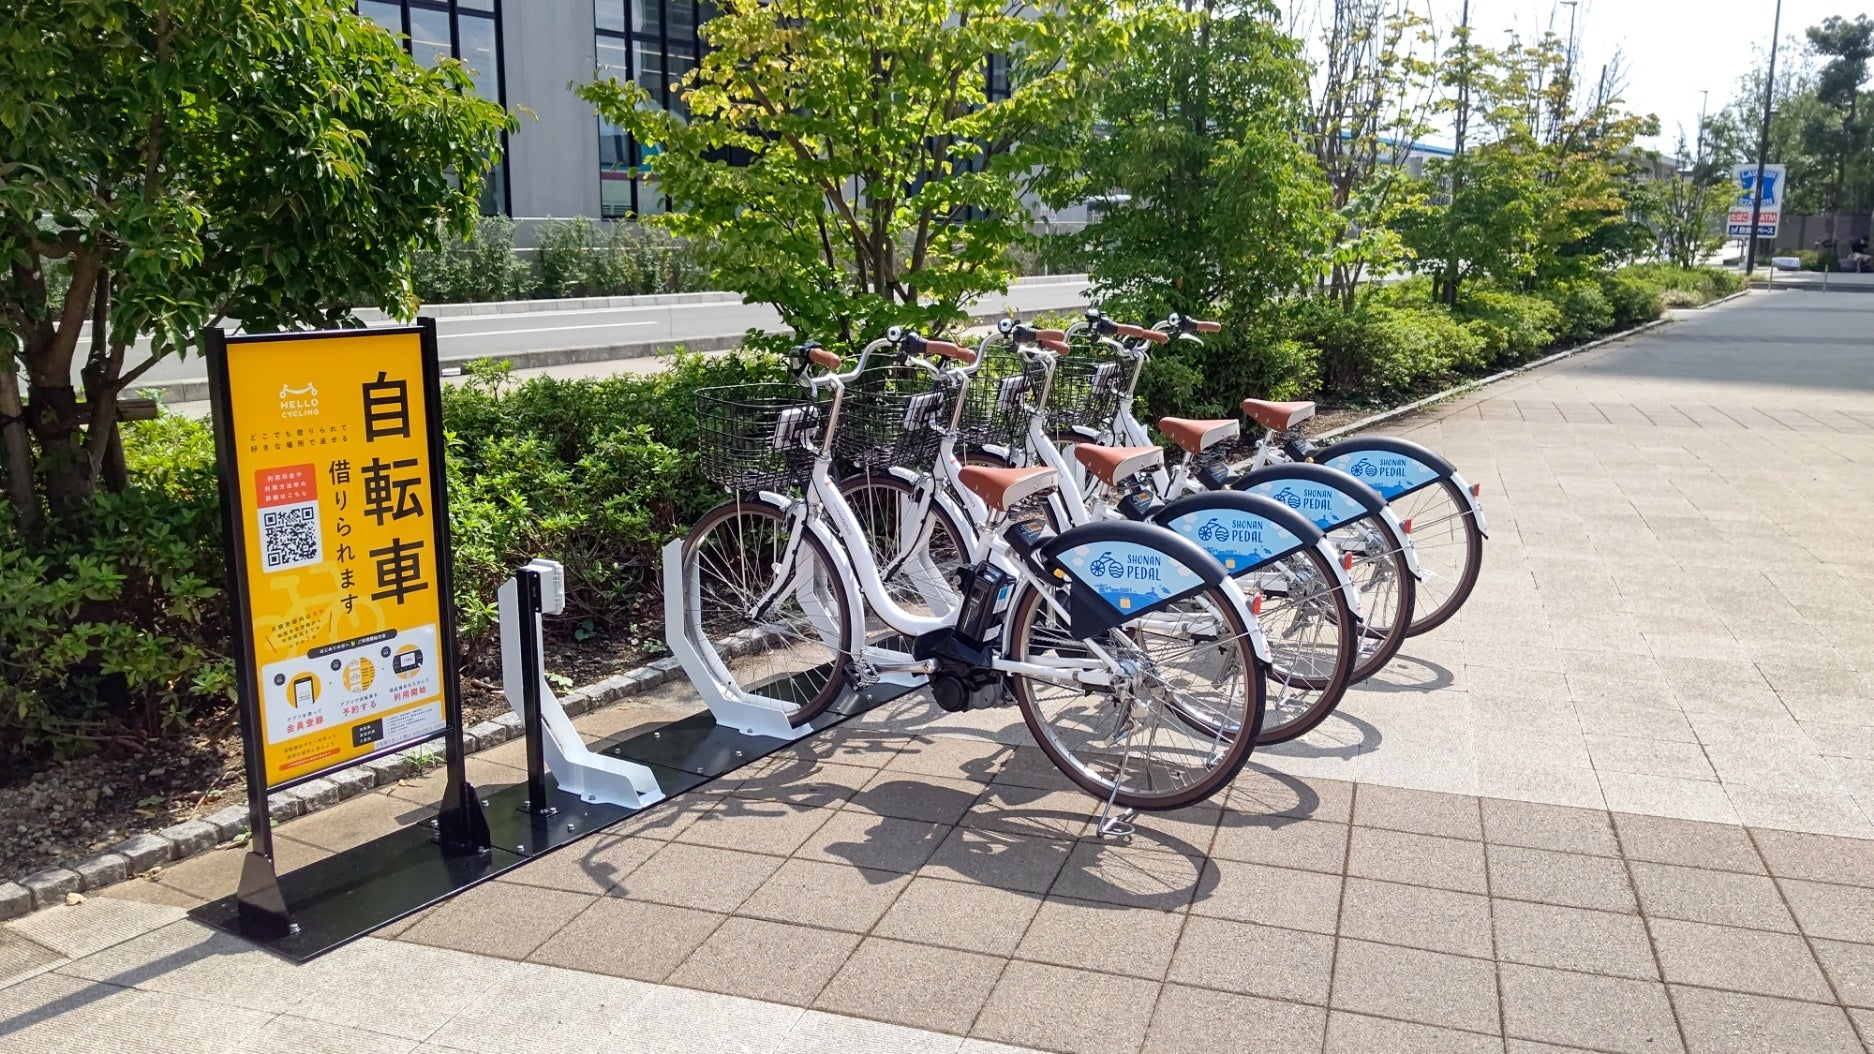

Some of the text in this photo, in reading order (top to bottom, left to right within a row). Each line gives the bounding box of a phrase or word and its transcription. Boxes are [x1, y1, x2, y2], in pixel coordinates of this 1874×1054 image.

[1760, 214, 1777, 222] ATM
[280, 399, 319, 409] HELLO
[281, 408, 320, 418] CYCLING
[250, 424, 348, 442] どこでも借りられて
[250, 435, 348, 453] 好きな場所で返せる
[1380, 459, 1407, 467] SHONAN
[1380, 467, 1407, 477] PEDAL
[361, 371, 429, 605] 自転車
[1303, 489, 1333, 499] SHONAN
[1303, 499, 1333, 511] PEDAL
[1232, 519, 1263, 530] SHONAN
[329, 459, 358, 614] 借りられます
[1232, 530, 1263, 543] PEDAL
[1127, 554, 1162, 566] SHONAN
[1127, 566, 1162, 581] PEDAL
[342, 700, 377, 717] 予約する
